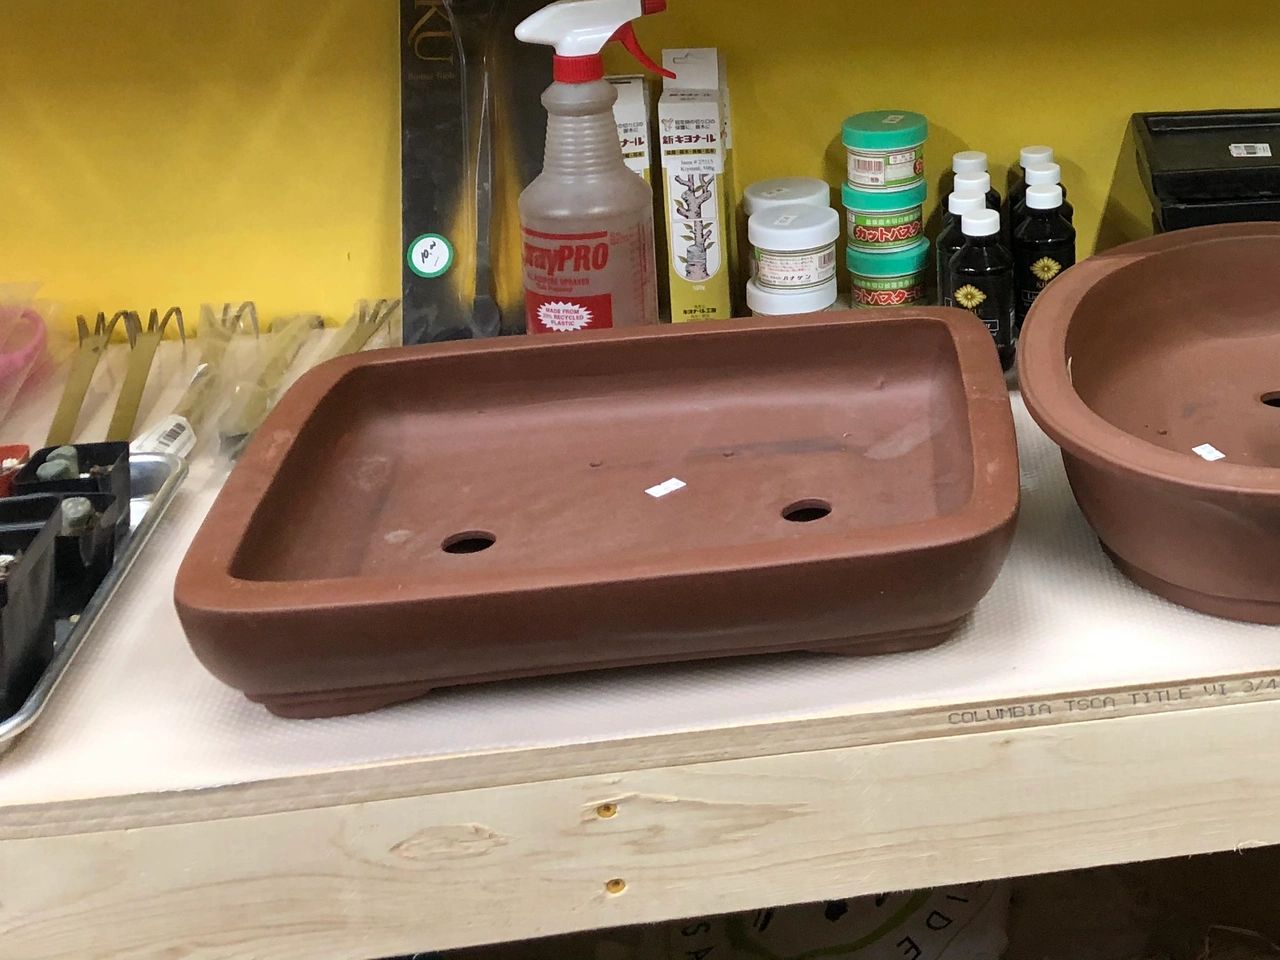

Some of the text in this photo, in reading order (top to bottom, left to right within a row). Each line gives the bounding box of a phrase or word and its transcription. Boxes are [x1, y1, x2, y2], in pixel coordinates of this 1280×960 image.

[948, 703, 1052, 725] COLUMBIA
[1064, 696, 1116, 711] TSCA
[1130, 687, 1193, 704] TITLE
